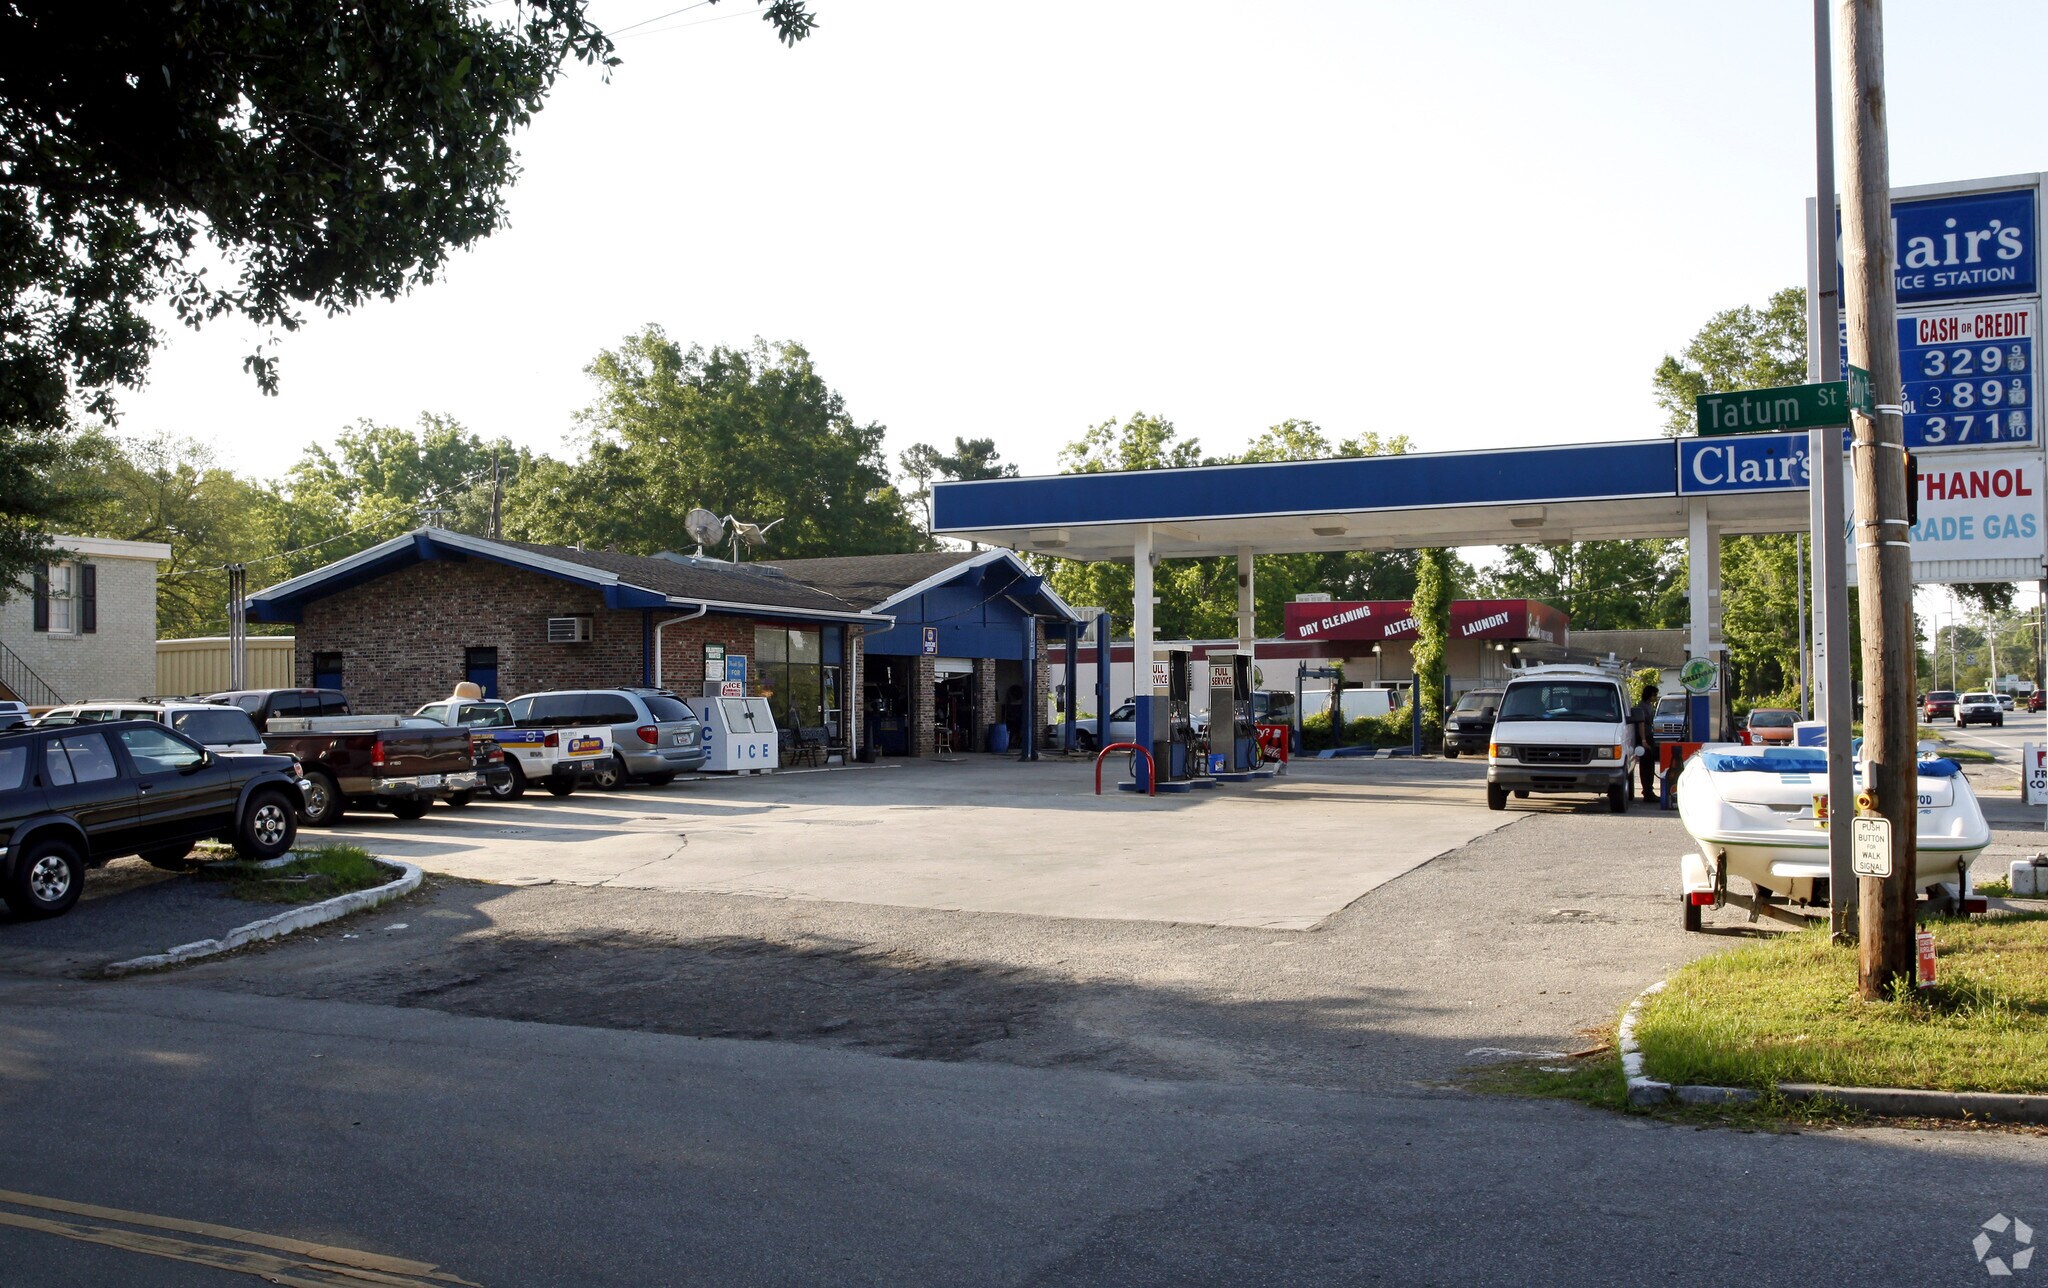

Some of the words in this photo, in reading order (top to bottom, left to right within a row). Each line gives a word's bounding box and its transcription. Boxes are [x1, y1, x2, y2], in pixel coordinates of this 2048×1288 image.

[1837, 217, 2024, 270] lair's
[1933, 265, 2016, 287] STATION
[1919, 317, 1959, 344] CASH
[1961, 322, 1973, 334] OR
[1974, 311, 2029, 339] CREDIT
[1924, 346, 2003, 377] 329
[1925, 379, 2003, 408] 389
[1706, 396, 1799, 429] Tatum
[1817, 387, 1838, 407] St
[1924, 413, 2000, 443] 371
[1692, 445, 1810, 486] Clair's
[1982, 513, 2037, 540] GAS
[1299, 621, 1320, 637] DRY
[1321, 605, 1371, 630] CLEANING
[1461, 611, 1510, 637] LAUNDRY
[1152, 664, 1164, 674] ULL
[1211, 676, 1232, 686] SERVICE
[1215, 667, 1228, 676] FULL
[737, 743, 769, 760] ICE
[1858, 833, 1885, 843] BUTTON
[1861, 822, 1881, 832] PUSH
[1859, 861, 1884, 872] SIGNAL
[1862, 851, 1881, 860] WALK
